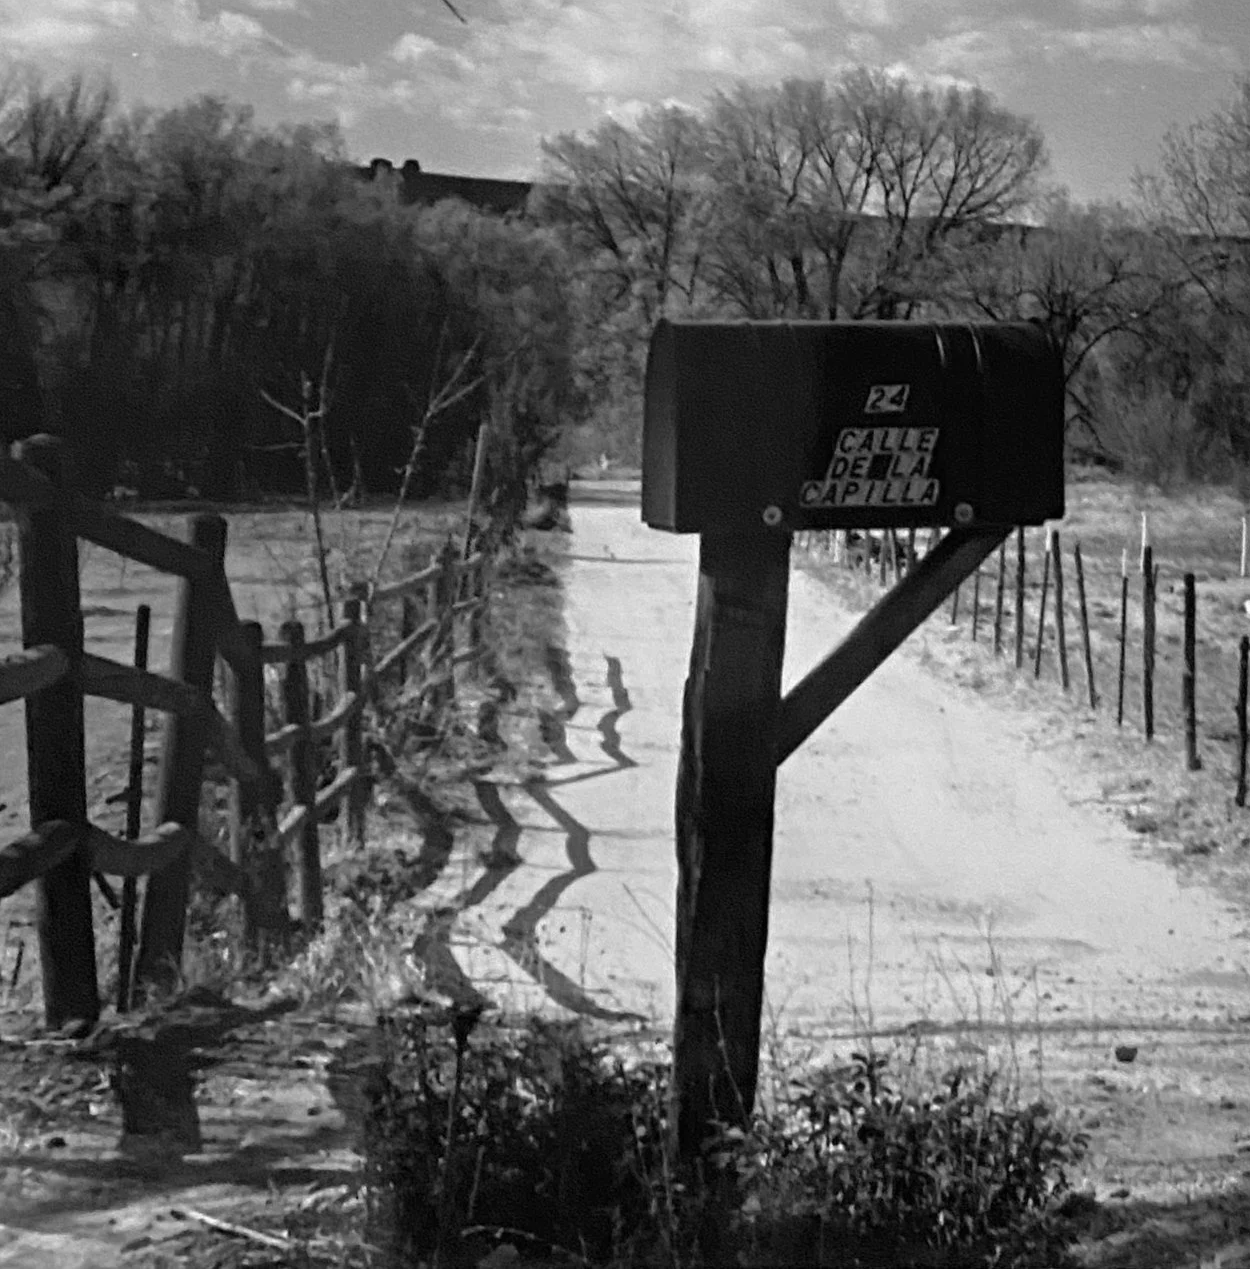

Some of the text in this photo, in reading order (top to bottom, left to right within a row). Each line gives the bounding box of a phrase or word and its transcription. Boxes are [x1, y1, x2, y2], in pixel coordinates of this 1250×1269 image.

[868, 387, 906, 410] 24
[839, 431, 934, 454] CALLE
[831, 456, 925, 479] DE LA
[803, 481, 936, 504] CAPILLA
